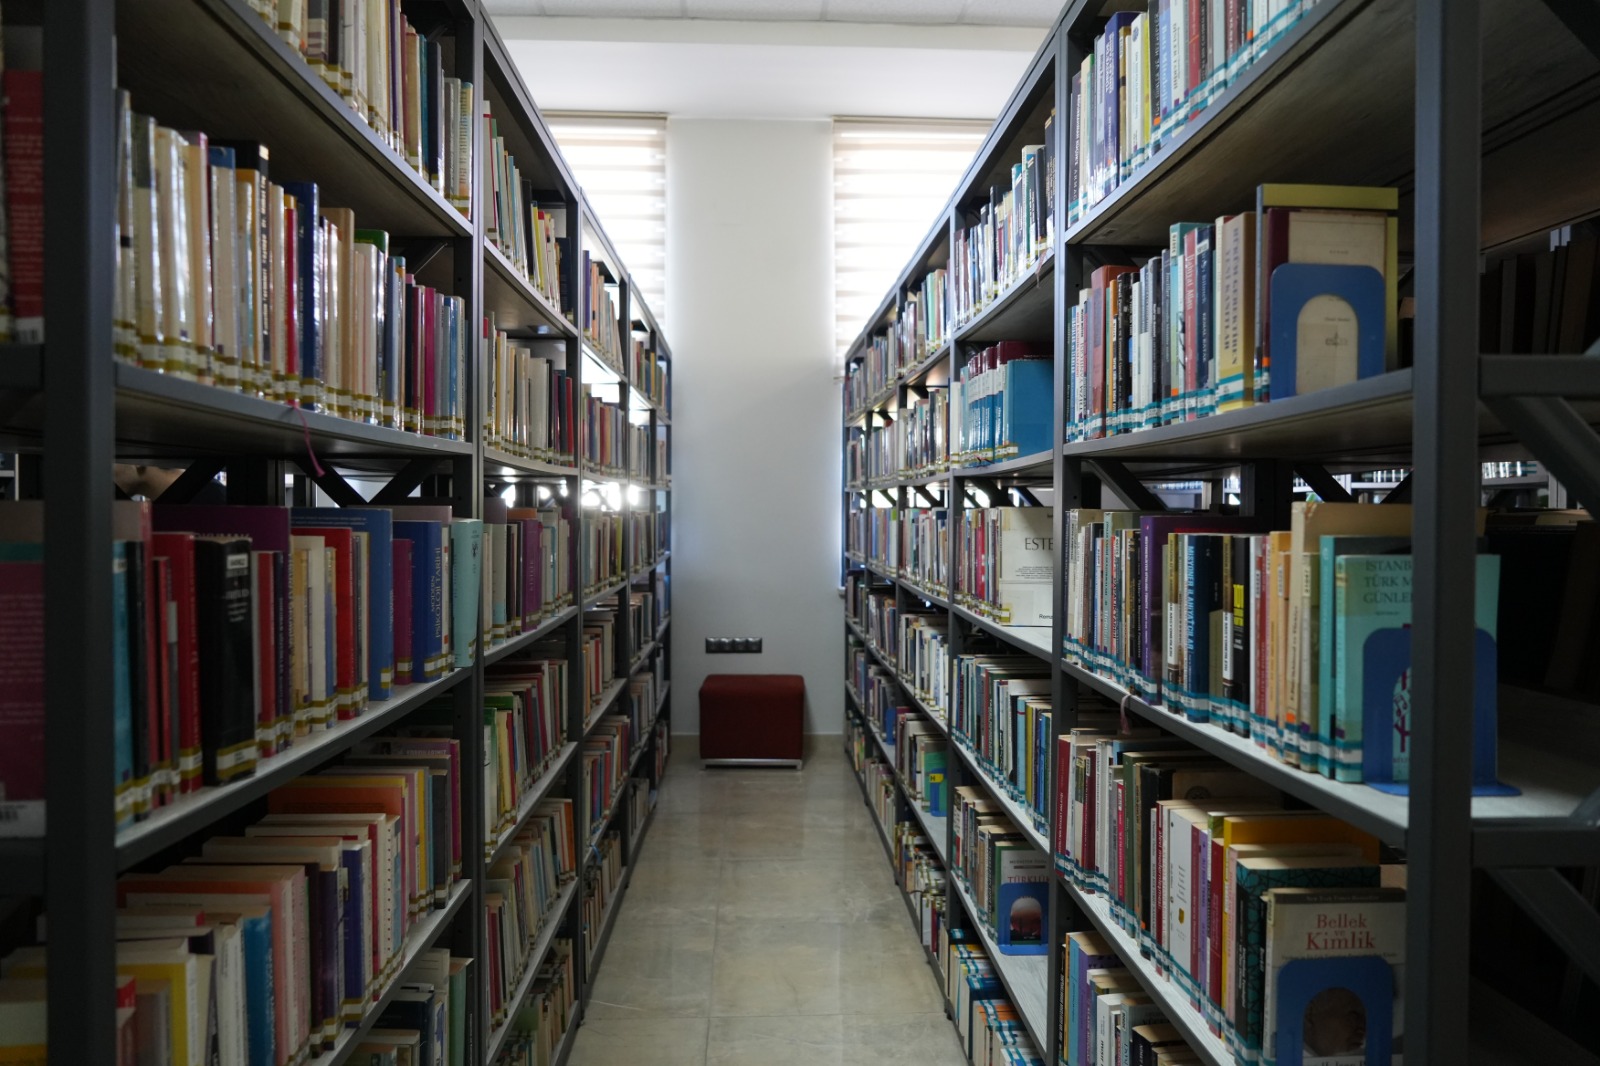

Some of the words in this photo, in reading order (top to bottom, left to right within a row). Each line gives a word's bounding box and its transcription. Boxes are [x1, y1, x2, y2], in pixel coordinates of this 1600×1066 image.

[1232, 227, 1240, 275] HÜKÜM
[1187, 545, 1195, 586] MİSYONER
[1364, 574, 1398, 588] TÜRK
[1317, 913, 1367, 929] Bellek
[1307, 931, 1376, 951] Kimlik
[1334, 929, 1345, 937] ve
